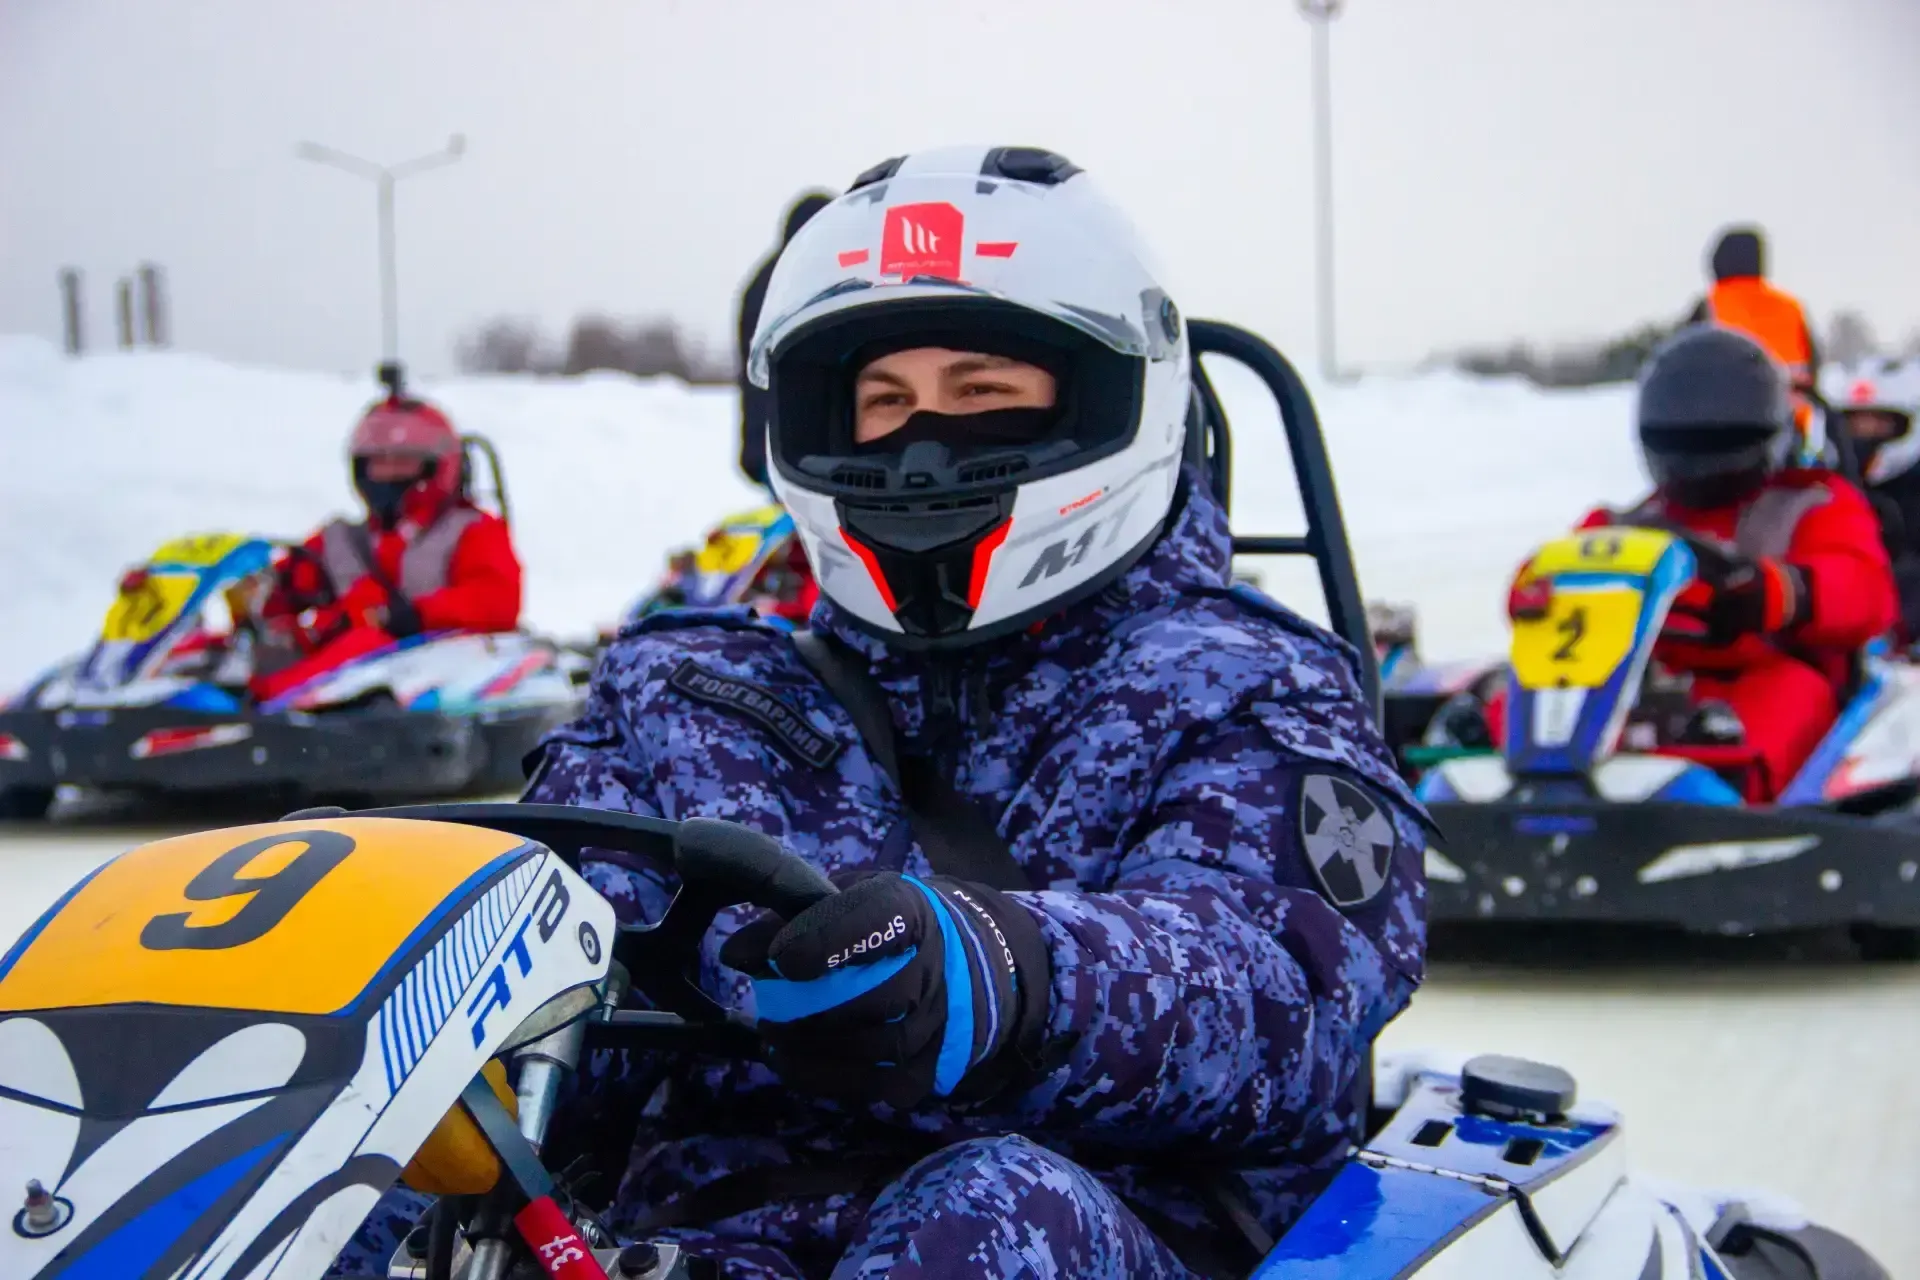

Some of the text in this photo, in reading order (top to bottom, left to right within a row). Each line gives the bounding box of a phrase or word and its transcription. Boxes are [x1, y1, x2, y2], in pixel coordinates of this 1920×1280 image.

[1552, 607, 1586, 661] 2
[687, 672, 823, 756] РОСГВАРДИЯ
[139, 828, 357, 951] 9
[827, 915, 906, 968] SPORTS
